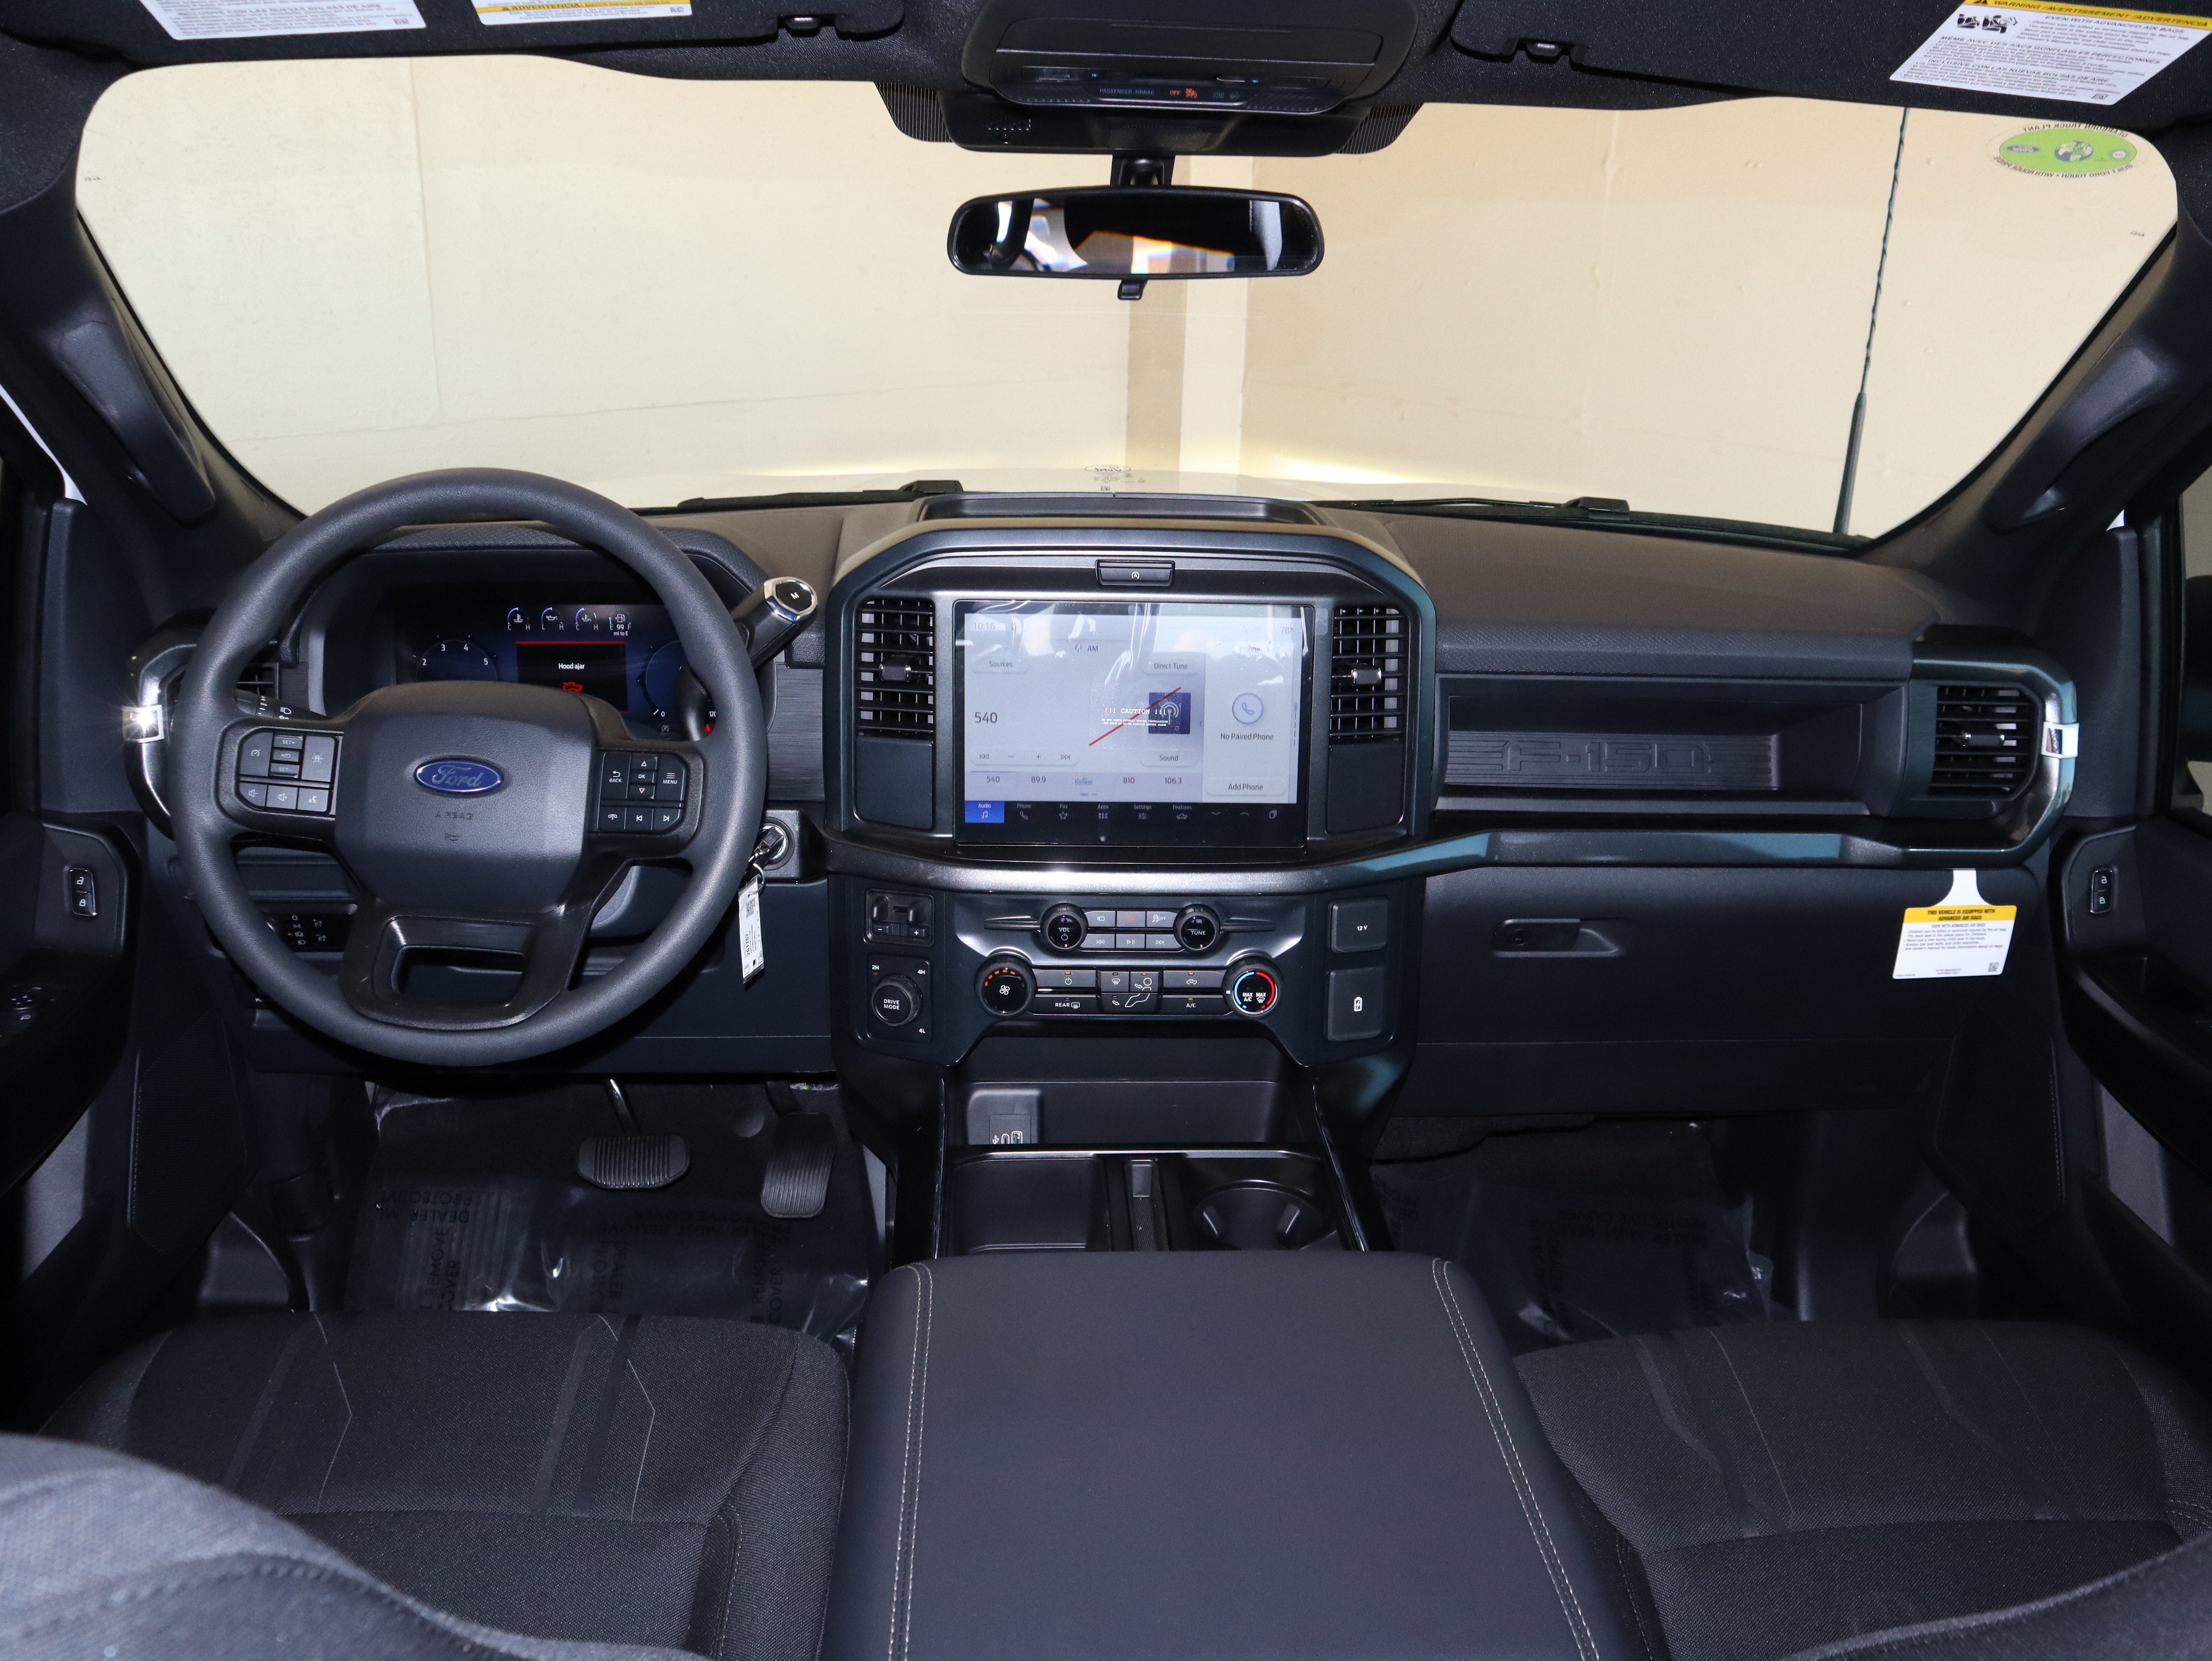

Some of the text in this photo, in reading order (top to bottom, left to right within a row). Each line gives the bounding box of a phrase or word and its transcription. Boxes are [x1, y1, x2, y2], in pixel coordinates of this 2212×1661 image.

[1928, 59, 1970, 68] INCLUSIVE
[974, 713, 998, 723] 540
[431, 765, 484, 787] Ford
[409, 1209, 470, 1224] DEALER
[425, 1227, 449, 1296] REMOVE
